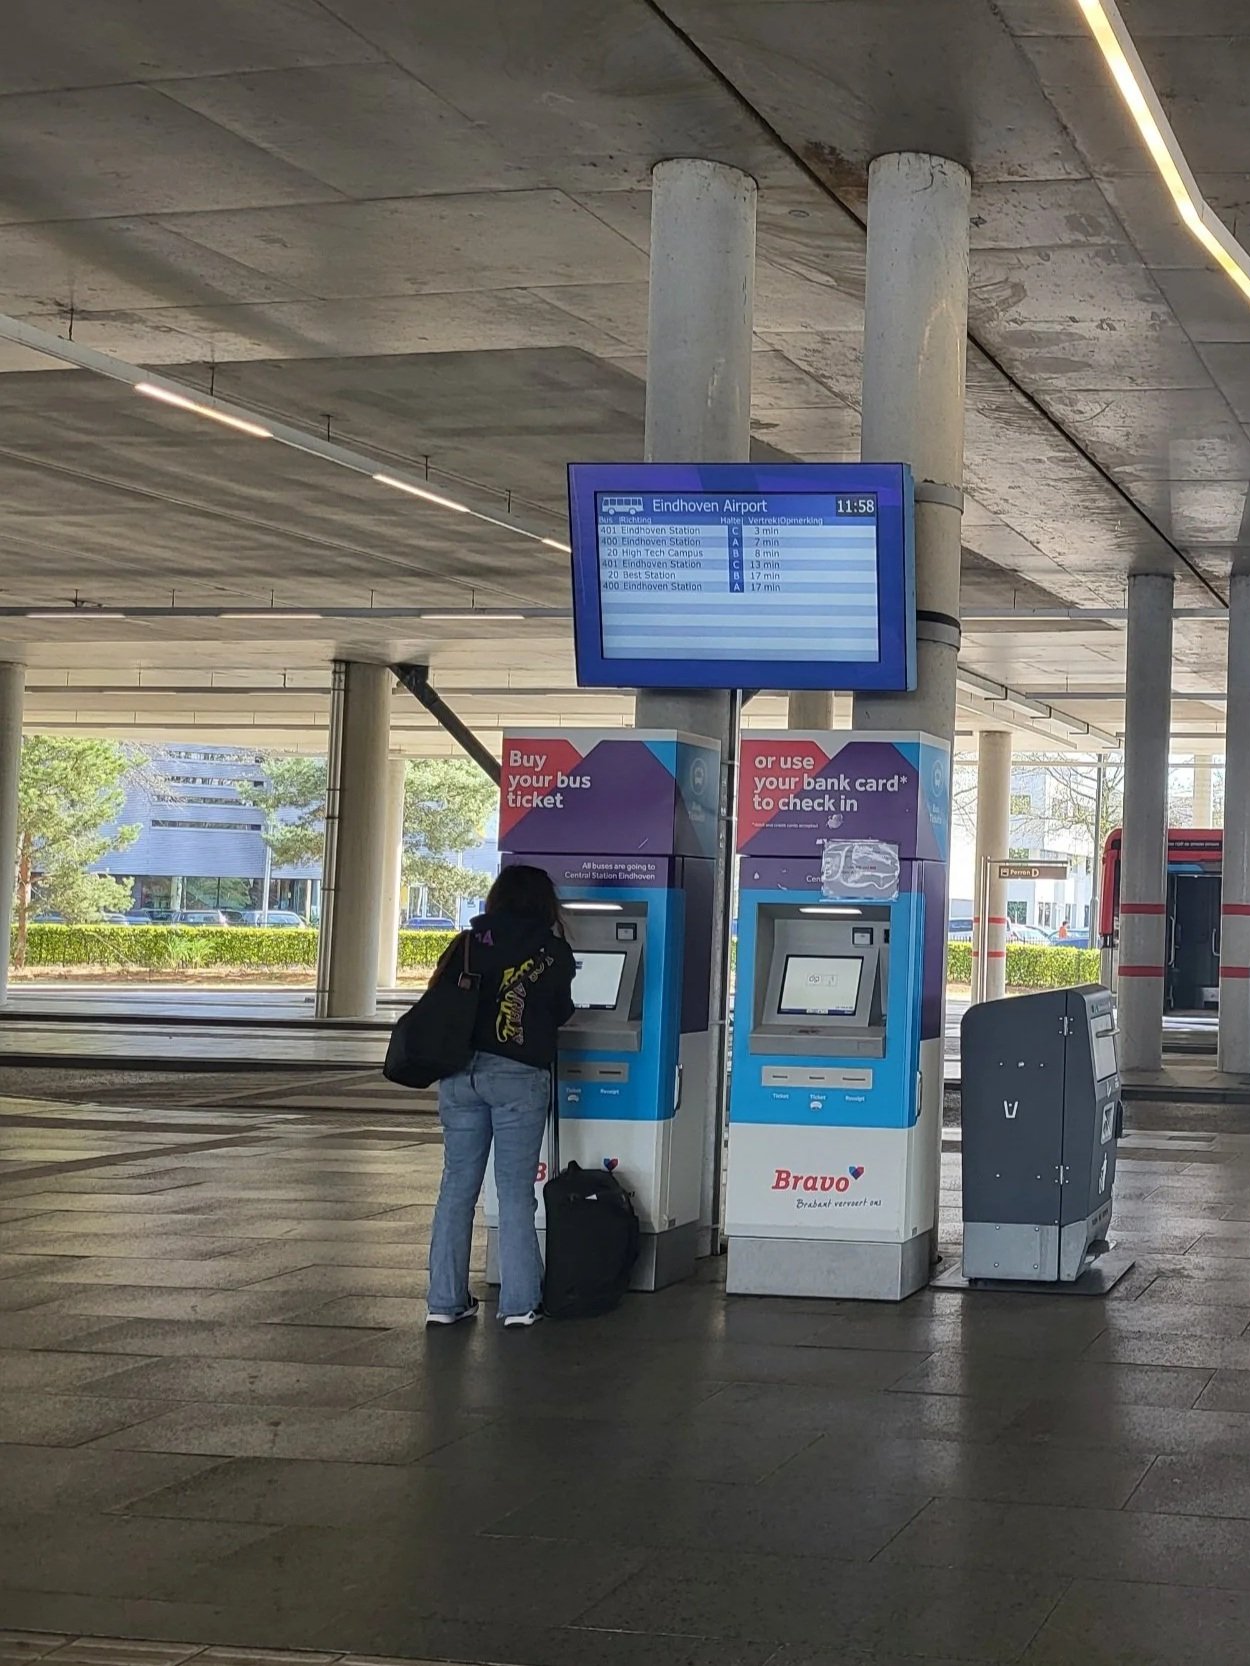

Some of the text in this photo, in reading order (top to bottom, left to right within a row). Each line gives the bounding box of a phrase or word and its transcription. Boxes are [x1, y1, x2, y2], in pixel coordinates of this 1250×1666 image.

[652, 499, 768, 515] Eindhoven Airport
[837, 499, 875, 513] 11:58
[621, 516, 652, 525] Richting
[721, 517, 741, 525] Halte
[600, 526, 779, 535] 401 Eindhoven Station C 3 min
[601, 537, 780, 546] 400 Eindhoven Station A 7 min
[607, 549, 618, 557] 20
[622, 549, 642, 558] High
[645, 549, 665, 557] Tech
[667, 549, 704, 558] Campus
[763, 549, 780, 557] min
[601, 560, 780, 569] 401 Eindhoven Station C 13 min
[608, 571, 780, 580] 20 Best Station B 17 min
[602, 581, 781, 591] 400 Eindhoven Station A 17 min
[509, 750, 547, 771] Buy
[754, 755, 815, 769] or use
[508, 771, 591, 791] your bus
[753, 775, 799, 793] your
[803, 773, 850, 791] bank
[507, 791, 564, 808] ticket
[752, 794, 858, 812] to check in
[581, 862, 591, 870] All
[592, 862, 613, 870] buses
[626, 863, 647, 871] going
[564, 871, 656, 880] Central Station Eindhoven
[1031, 868, 1040, 878] D
[809, 1093, 827, 1101] Ticket
[771, 1169, 850, 1193] Bravo
[796, 1197, 882, 1210] Brabant vervoert ons
